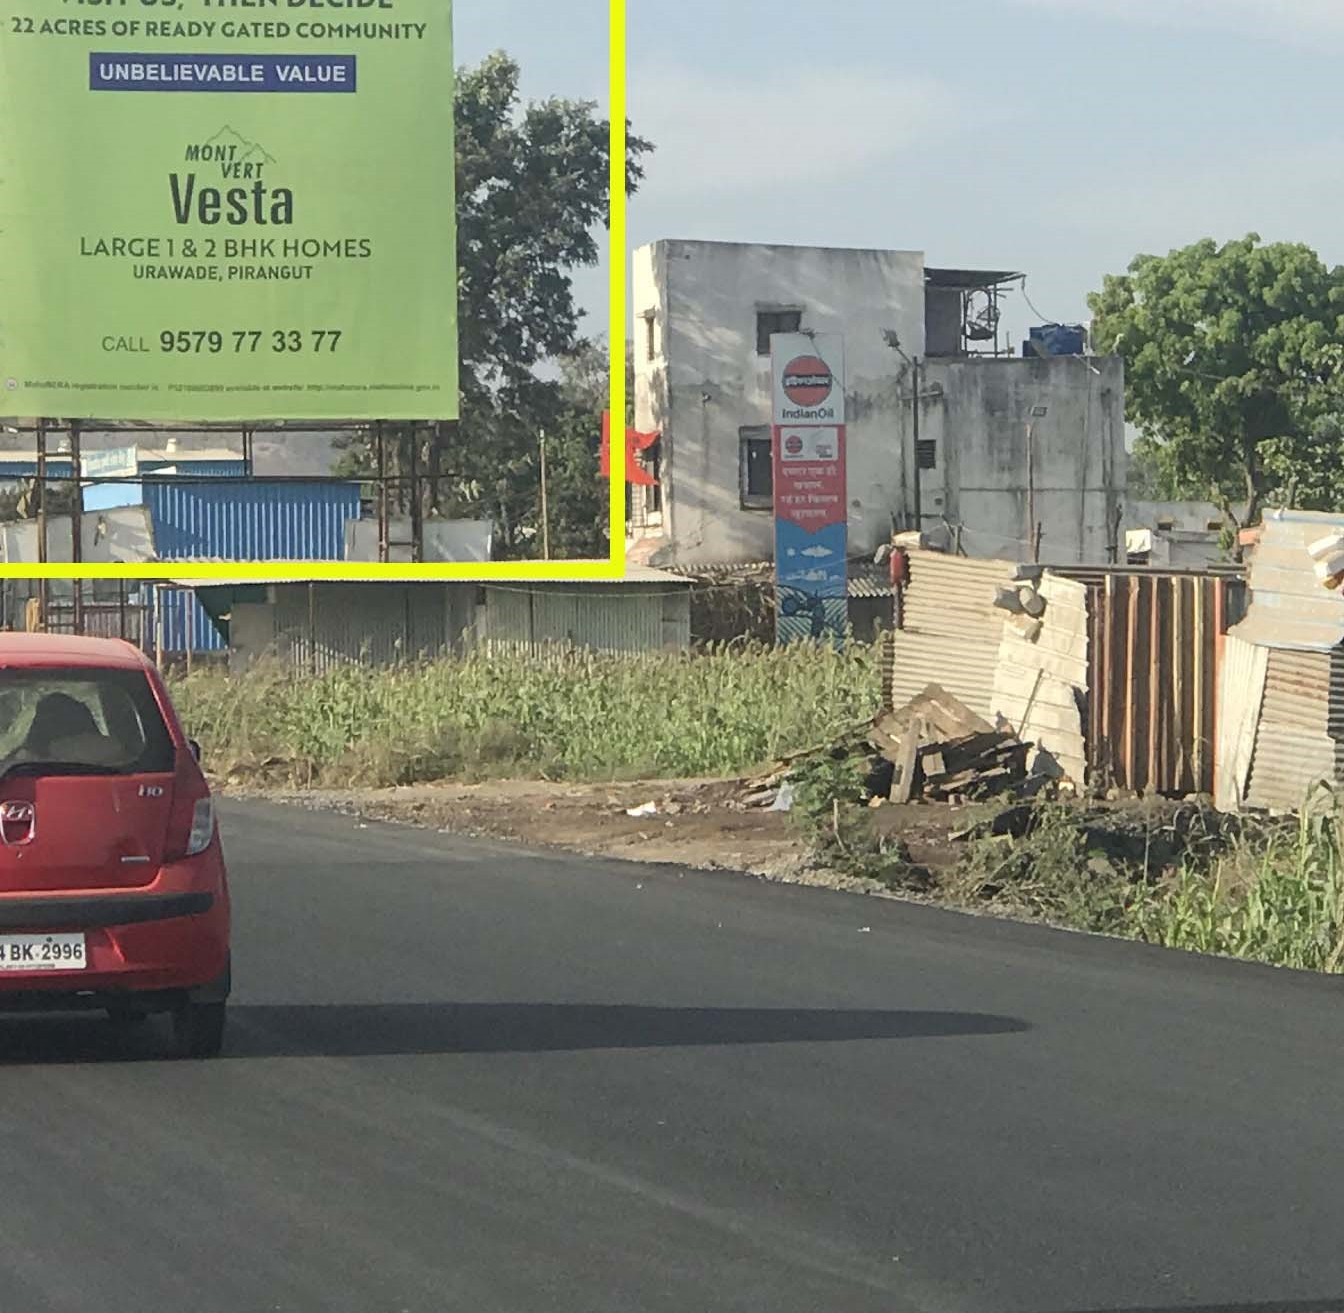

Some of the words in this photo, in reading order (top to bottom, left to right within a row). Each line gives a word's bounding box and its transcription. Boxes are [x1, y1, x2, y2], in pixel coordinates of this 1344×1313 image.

[11, 17, 34, 34] 22
[40, 19, 106, 36] ACRES
[112, 21, 140, 37] OF
[146, 21, 214, 38] READY
[221, 22, 290, 39] GATED
[295, 22, 427, 40] COMMUNITY
[99, 63, 264, 82] UNBELIEVABLE
[275, 65, 346, 82] VALUE
[184, 145, 237, 162] MONT
[221, 163, 264, 179] VERT
[168, 173, 294, 225] Vesta
[80, 237, 160, 257] LARGE
[167, 238, 174, 257] 1
[182, 239, 197, 257] &
[205, 239, 216, 257] 2
[224, 239, 275, 258] BHK
[283, 239, 371, 258] HOMES
[132, 265, 223, 281] URAWADE,
[228, 266, 313, 280] PIRANGUT
[102, 336, 150, 352] CALL
[160, 331, 223, 353] 9579
[232, 332, 262, 352] 77
[272, 332, 303, 353] 33
[312, 332, 342, 352] 77
[782, 408, 834, 419] IndianOil
[10, 943, 34, 961] BK
[41, 943, 82, 960] 2996
